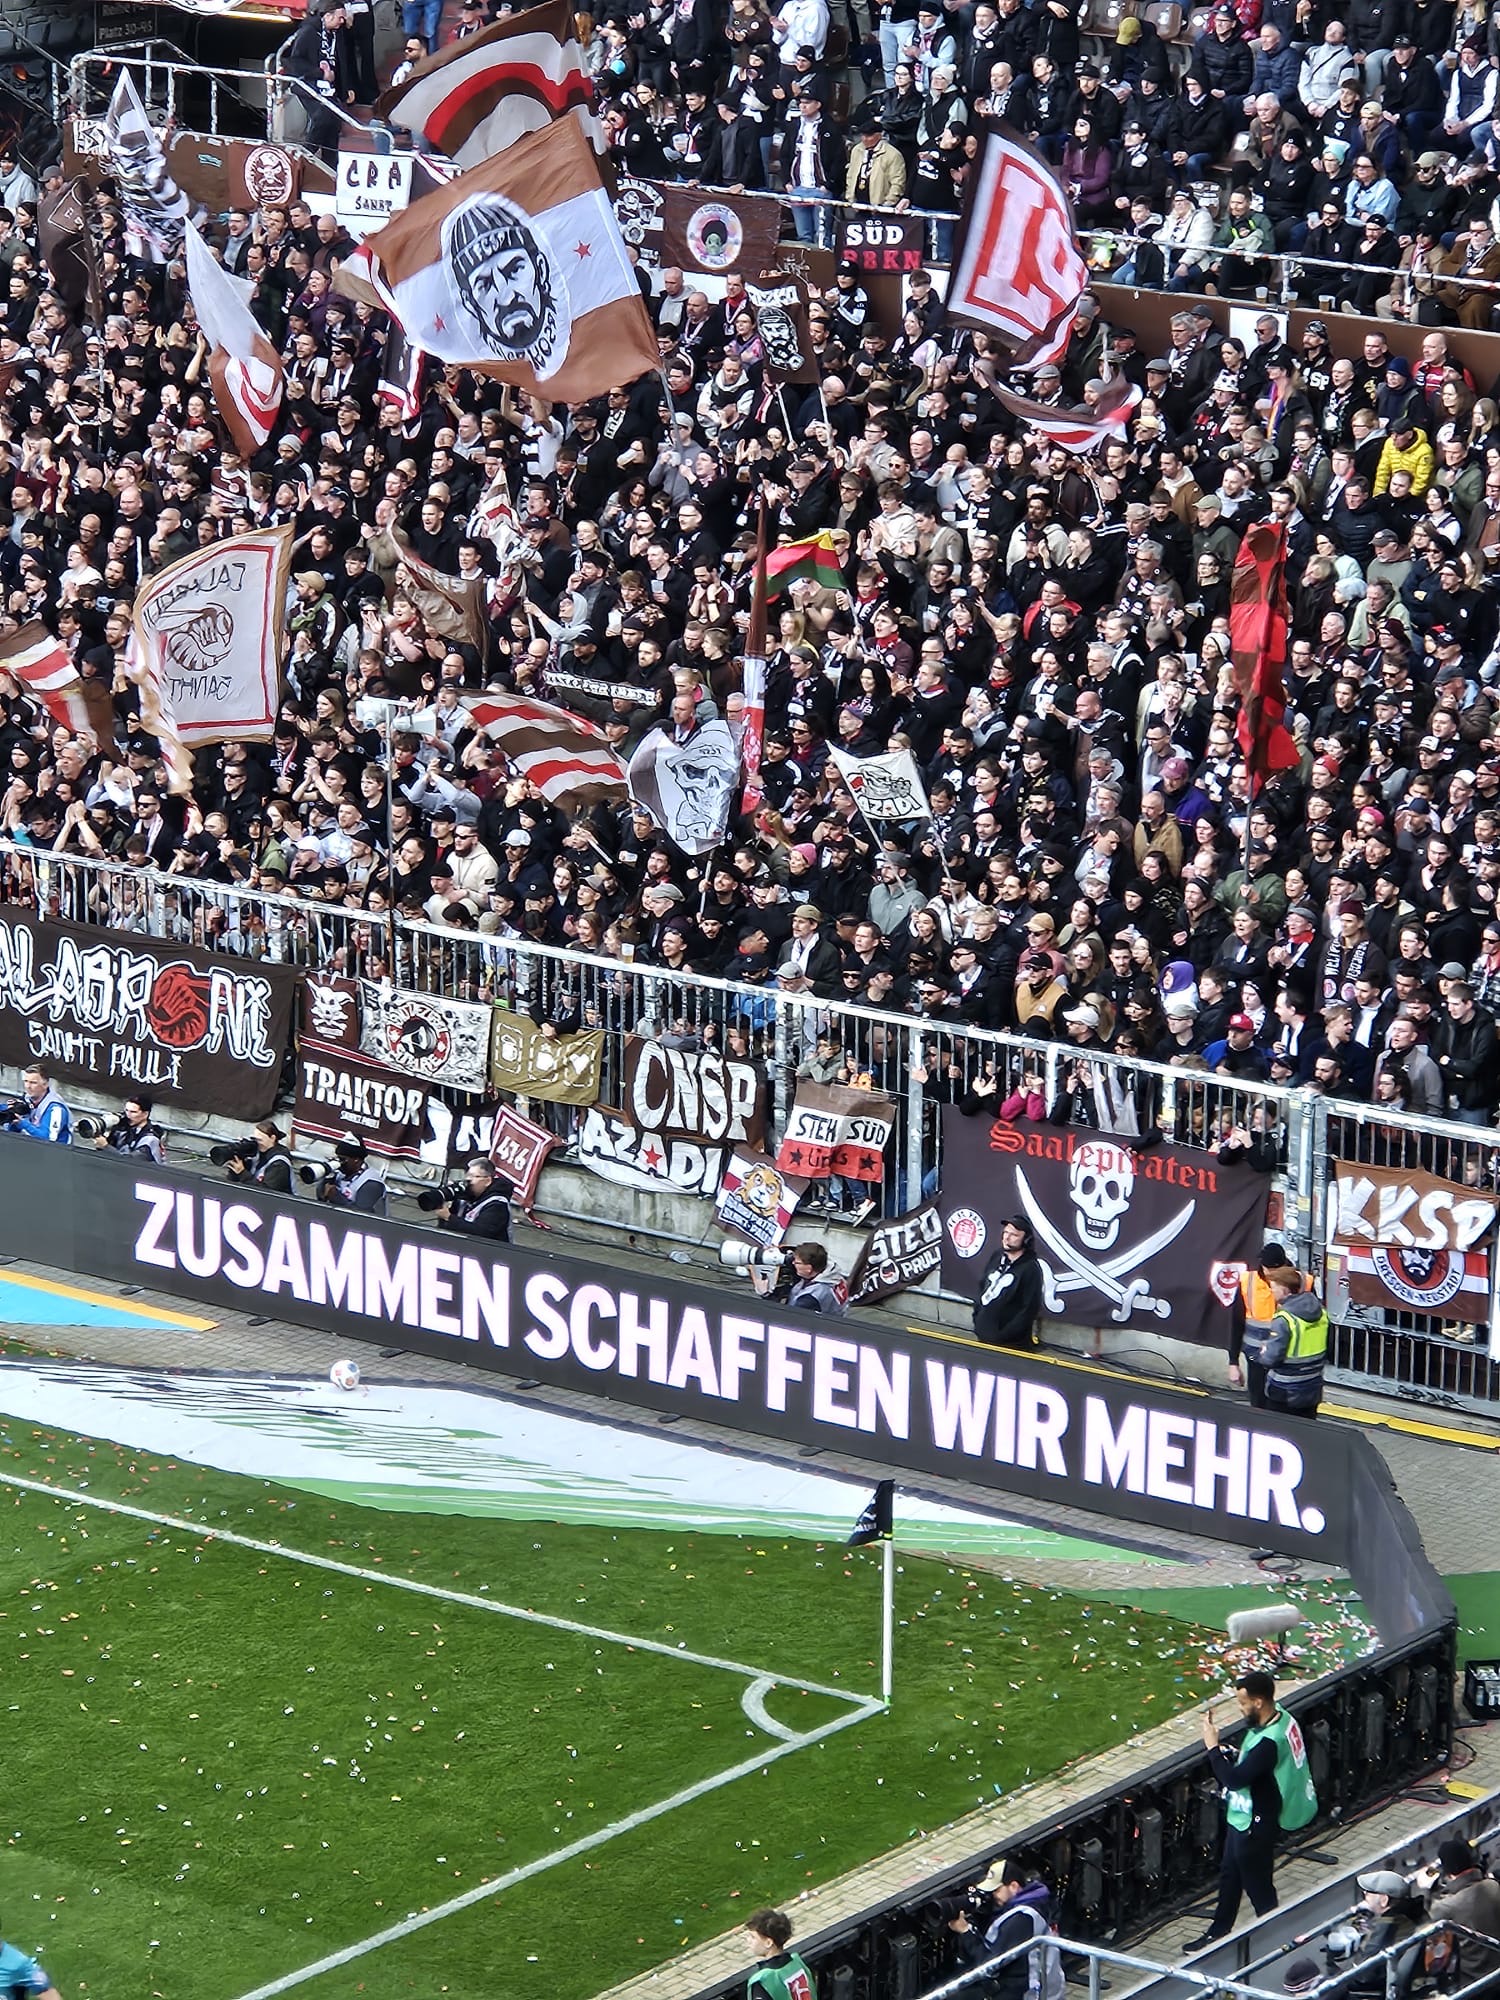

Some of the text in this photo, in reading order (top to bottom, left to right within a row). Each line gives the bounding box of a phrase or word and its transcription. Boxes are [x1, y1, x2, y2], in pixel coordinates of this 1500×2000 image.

[346, 159, 402, 190] CRA
[845, 220, 904, 246] SÜD
[857, 795, 923, 818] AZADI
[303, 1061, 424, 1127] TRAKTOR
[633, 1040, 757, 1141] CNSP
[581, 1107, 723, 1194] AZADI
[795, 1113, 886, 1145] STEH SÜD
[808, 1147, 848, 1168] lins
[989, 1120, 1217, 1193] Saalepiraten
[133, 1182, 1328, 1535] ZUSAMMEN SCHAFFEN WIR MEHR.
